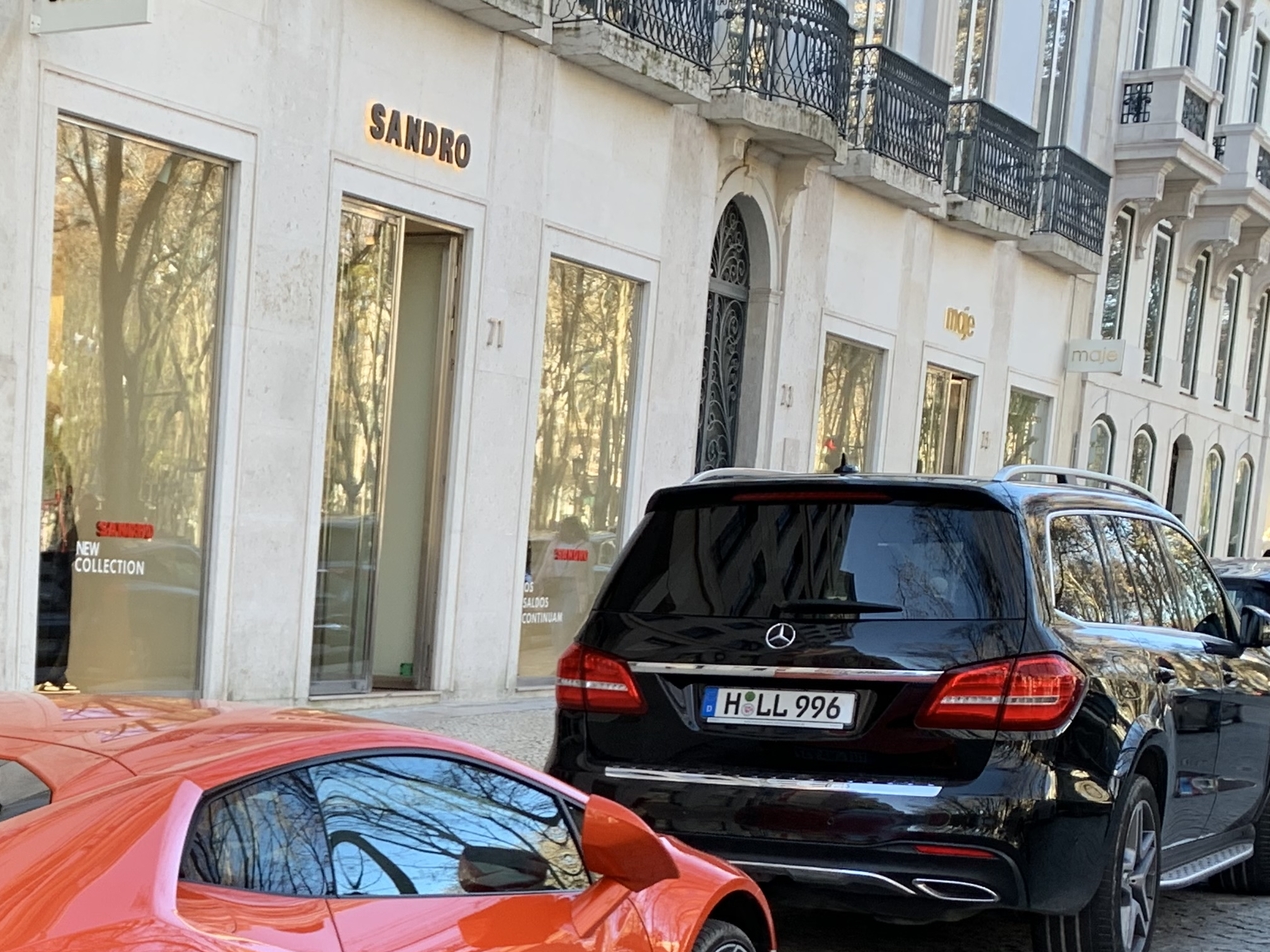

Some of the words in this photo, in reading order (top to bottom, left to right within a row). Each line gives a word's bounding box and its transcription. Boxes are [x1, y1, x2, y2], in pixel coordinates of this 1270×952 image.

[370, 103, 471, 169] SANDRO
[945, 306, 975, 341] maje
[1071, 347, 1118, 365] maje
[76, 541, 100, 556] NEW
[74, 557, 145, 575] COLLECTION
[522, 597, 549, 608] SALDOS
[522, 612, 563, 624] CONTINUAM
[724, 692, 741, 715] H
[757, 694, 787, 717] LL
[796, 695, 841, 719] 996
